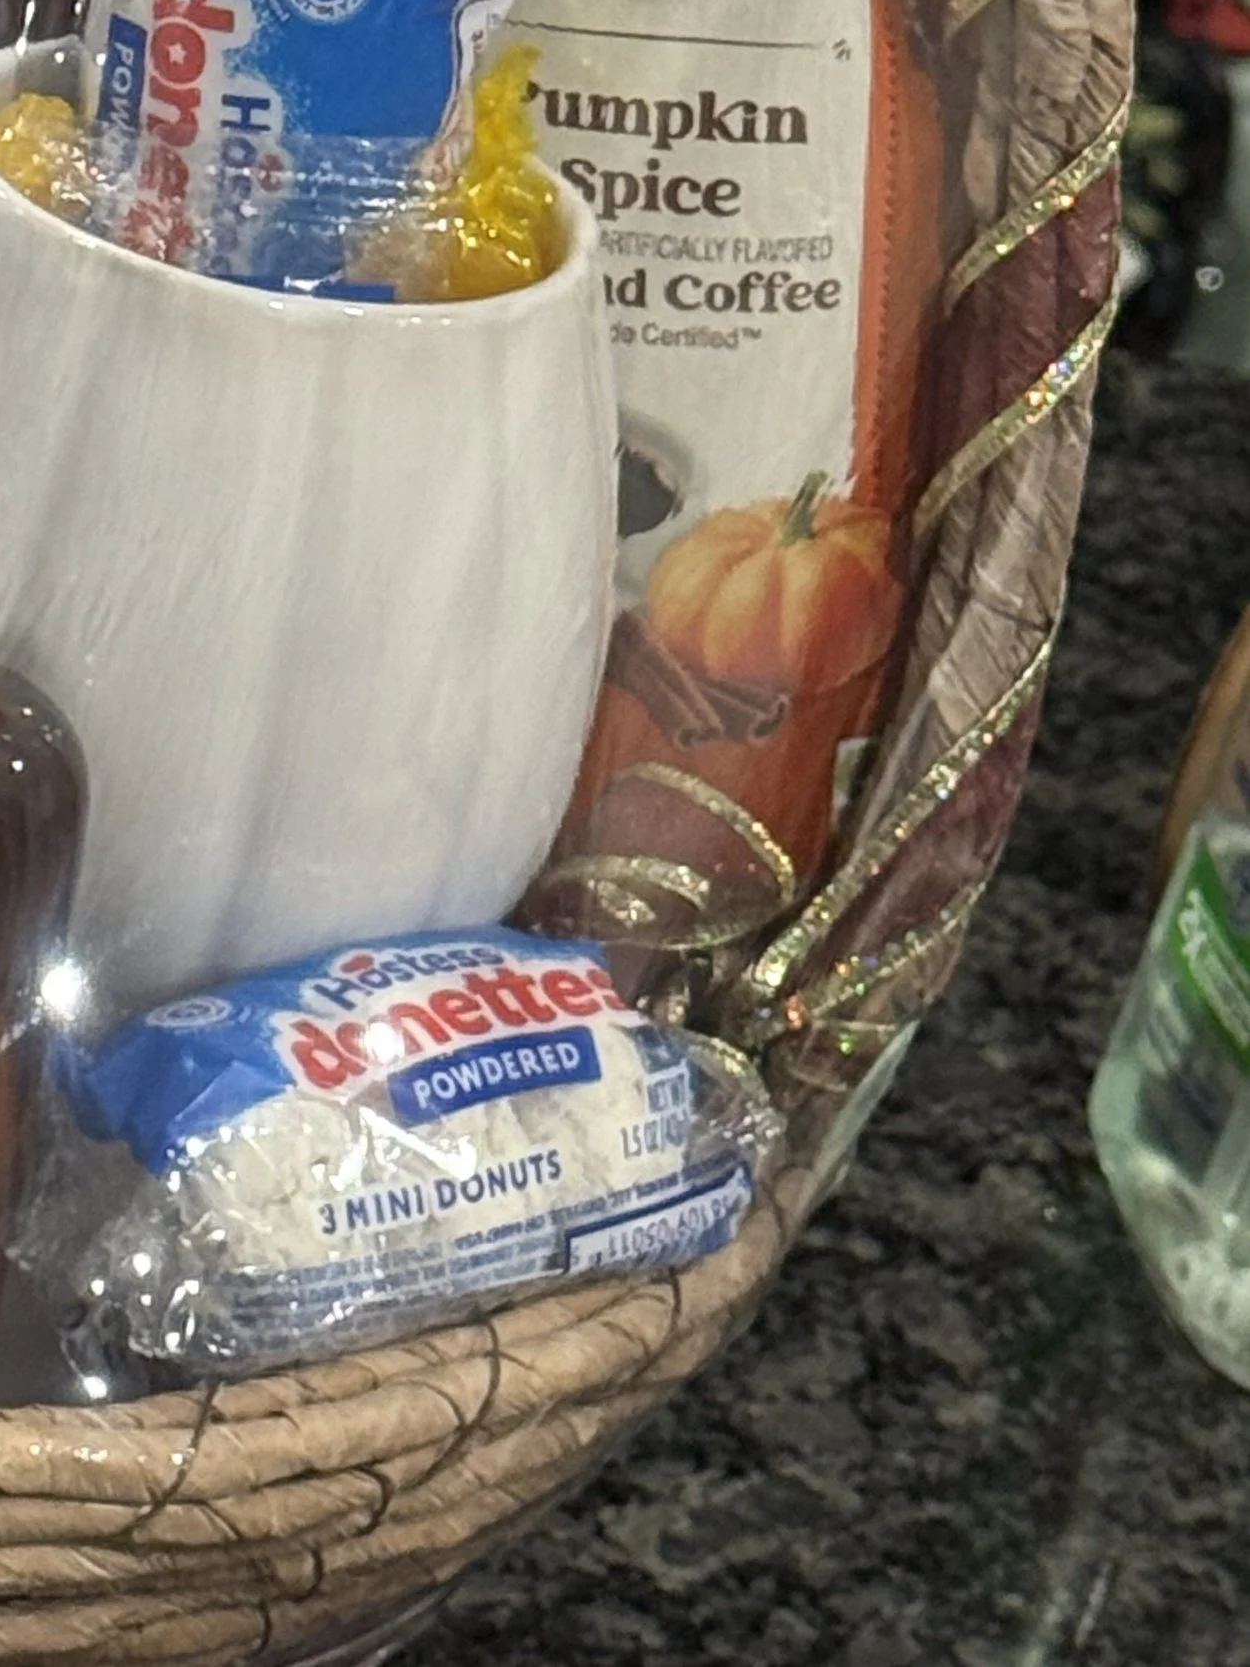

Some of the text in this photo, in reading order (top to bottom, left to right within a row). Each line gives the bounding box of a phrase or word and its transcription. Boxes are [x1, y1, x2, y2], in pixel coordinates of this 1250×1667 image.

[519, 80, 808, 150] umpkin
[560, 158, 742, 220] Spice
[731, 234, 834, 264] FLAVORED
[663, 270, 842, 313] Coffee
[312, 945, 507, 1012] Hostess
[411, 1042, 581, 1110] POWDERED
[317, 1201, 338, 1235] 3
[344, 1178, 426, 1230] MINI
[435, 1148, 563, 1212] DONUTS
